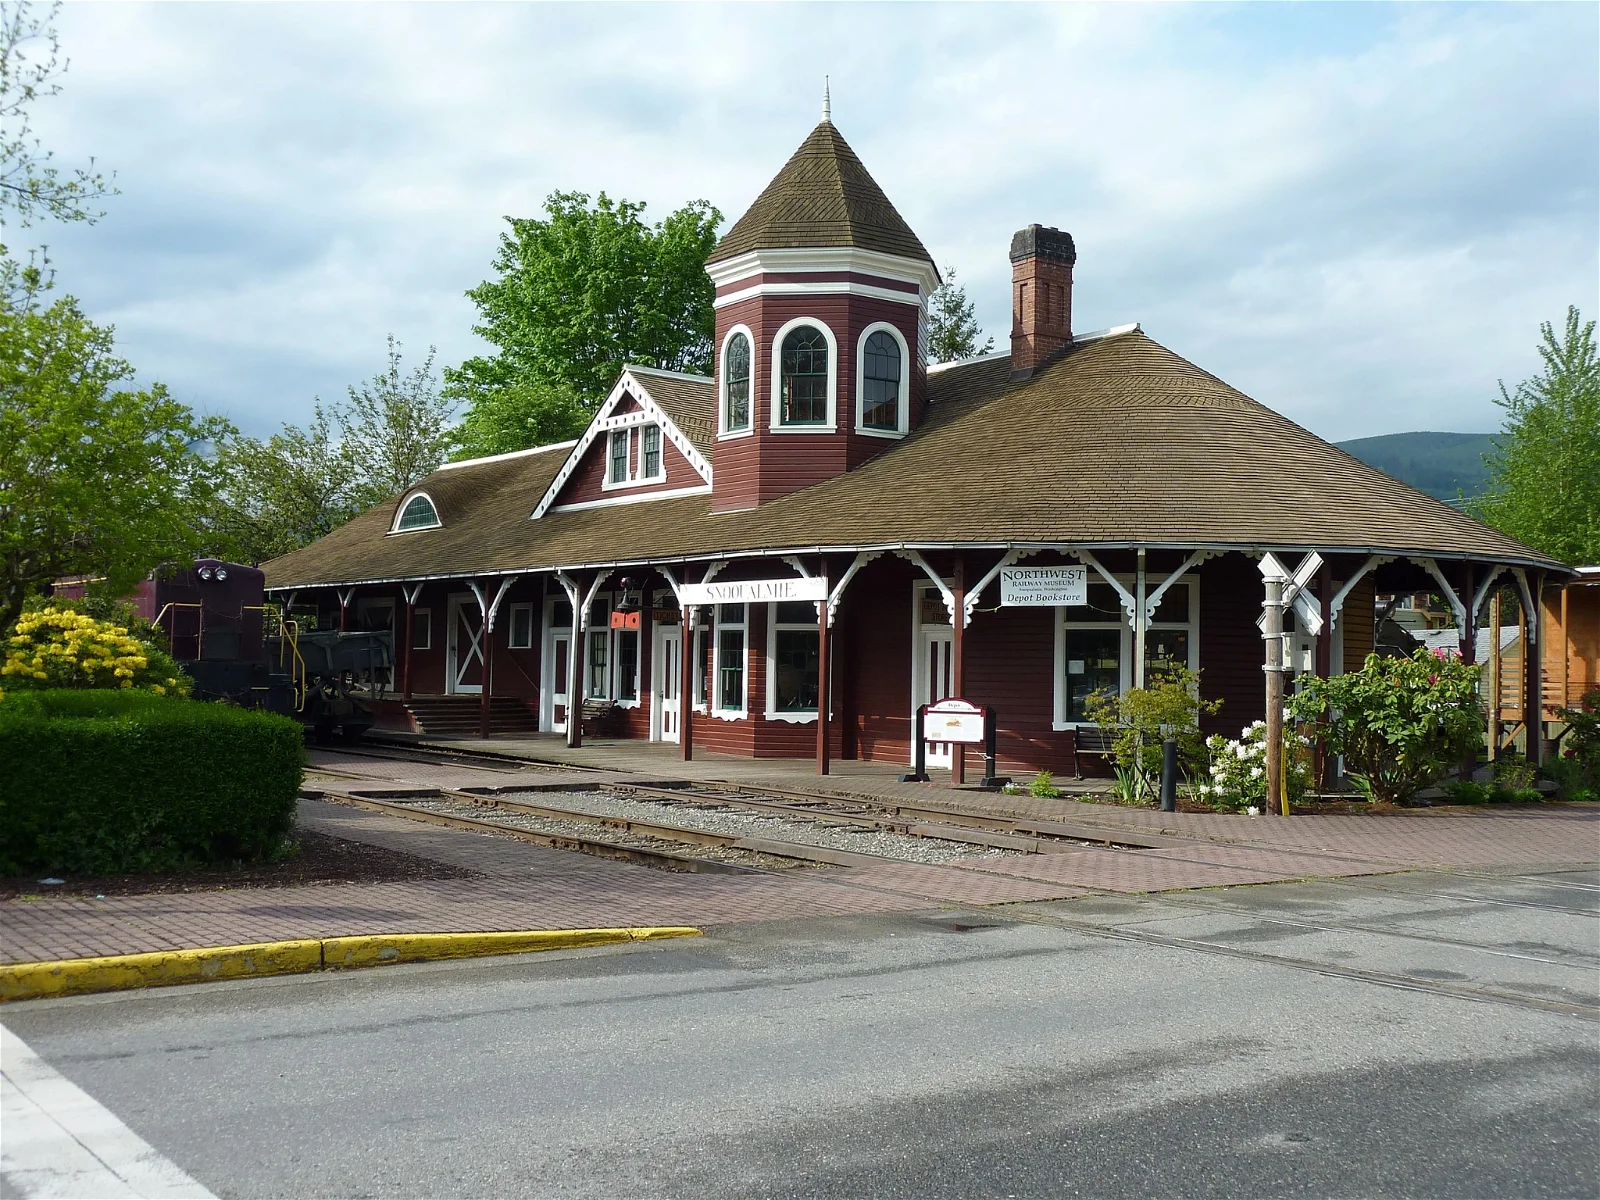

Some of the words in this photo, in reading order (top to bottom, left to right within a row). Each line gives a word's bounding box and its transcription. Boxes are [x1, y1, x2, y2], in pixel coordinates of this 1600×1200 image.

[1003, 570, 1085, 581] NORTHWEST
[1007, 594, 1033, 603] Depot
[1036, 593, 1080, 602] Bookstore
